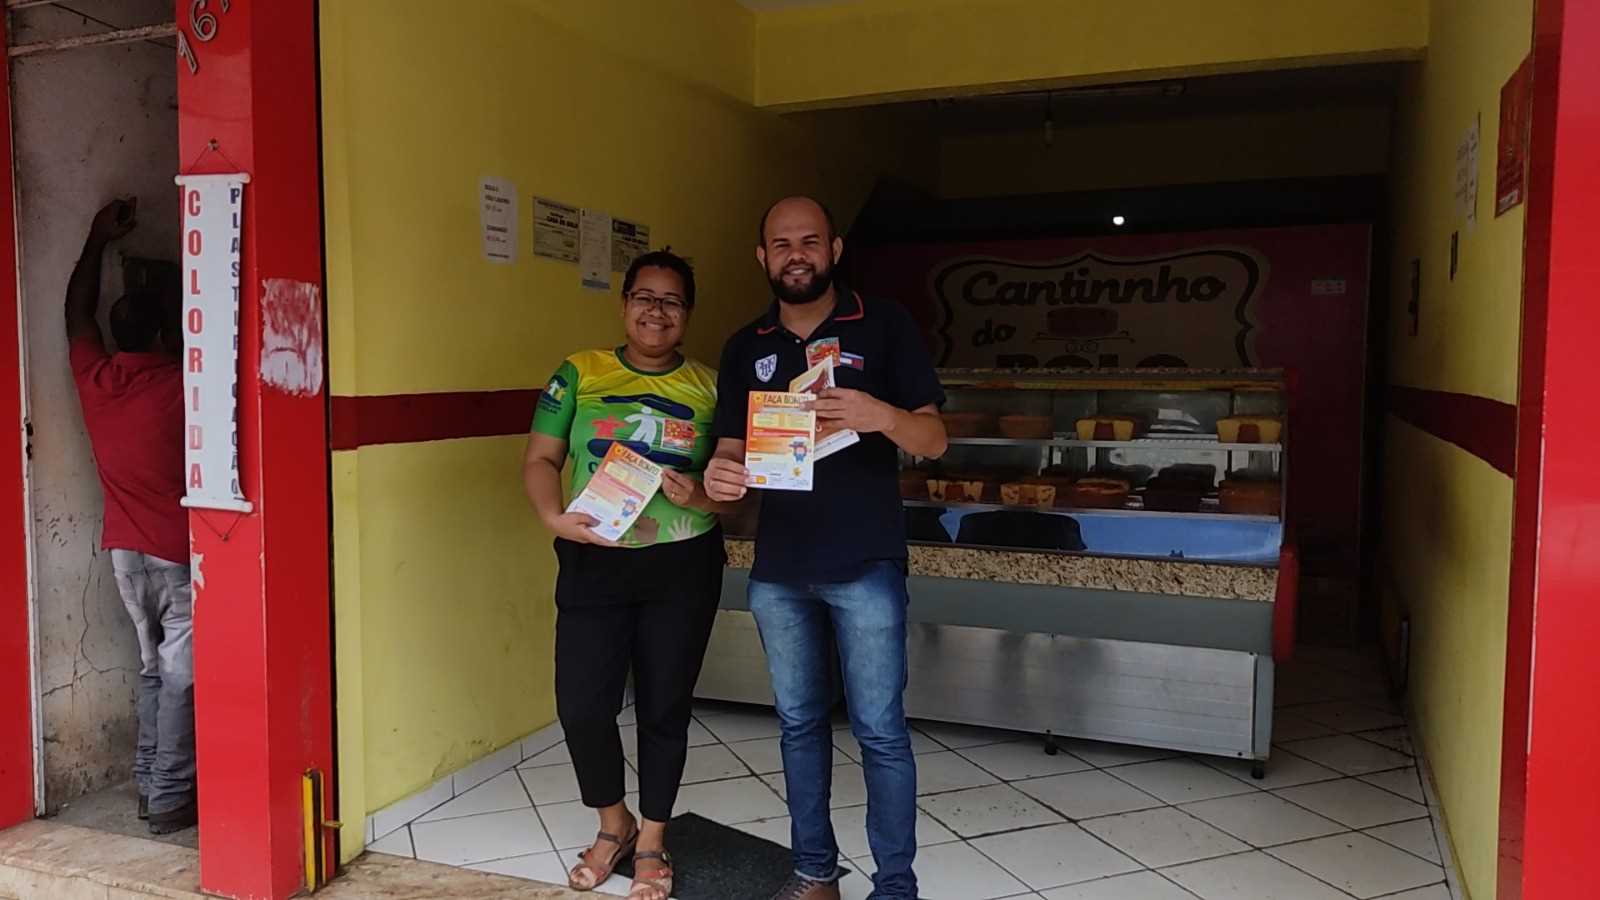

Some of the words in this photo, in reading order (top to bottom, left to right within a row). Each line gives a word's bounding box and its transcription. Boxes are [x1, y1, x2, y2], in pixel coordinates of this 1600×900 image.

[178, 0, 230, 75] 16
[188, 190, 204, 490] COLORIDA
[972, 319, 1016, 347] do
